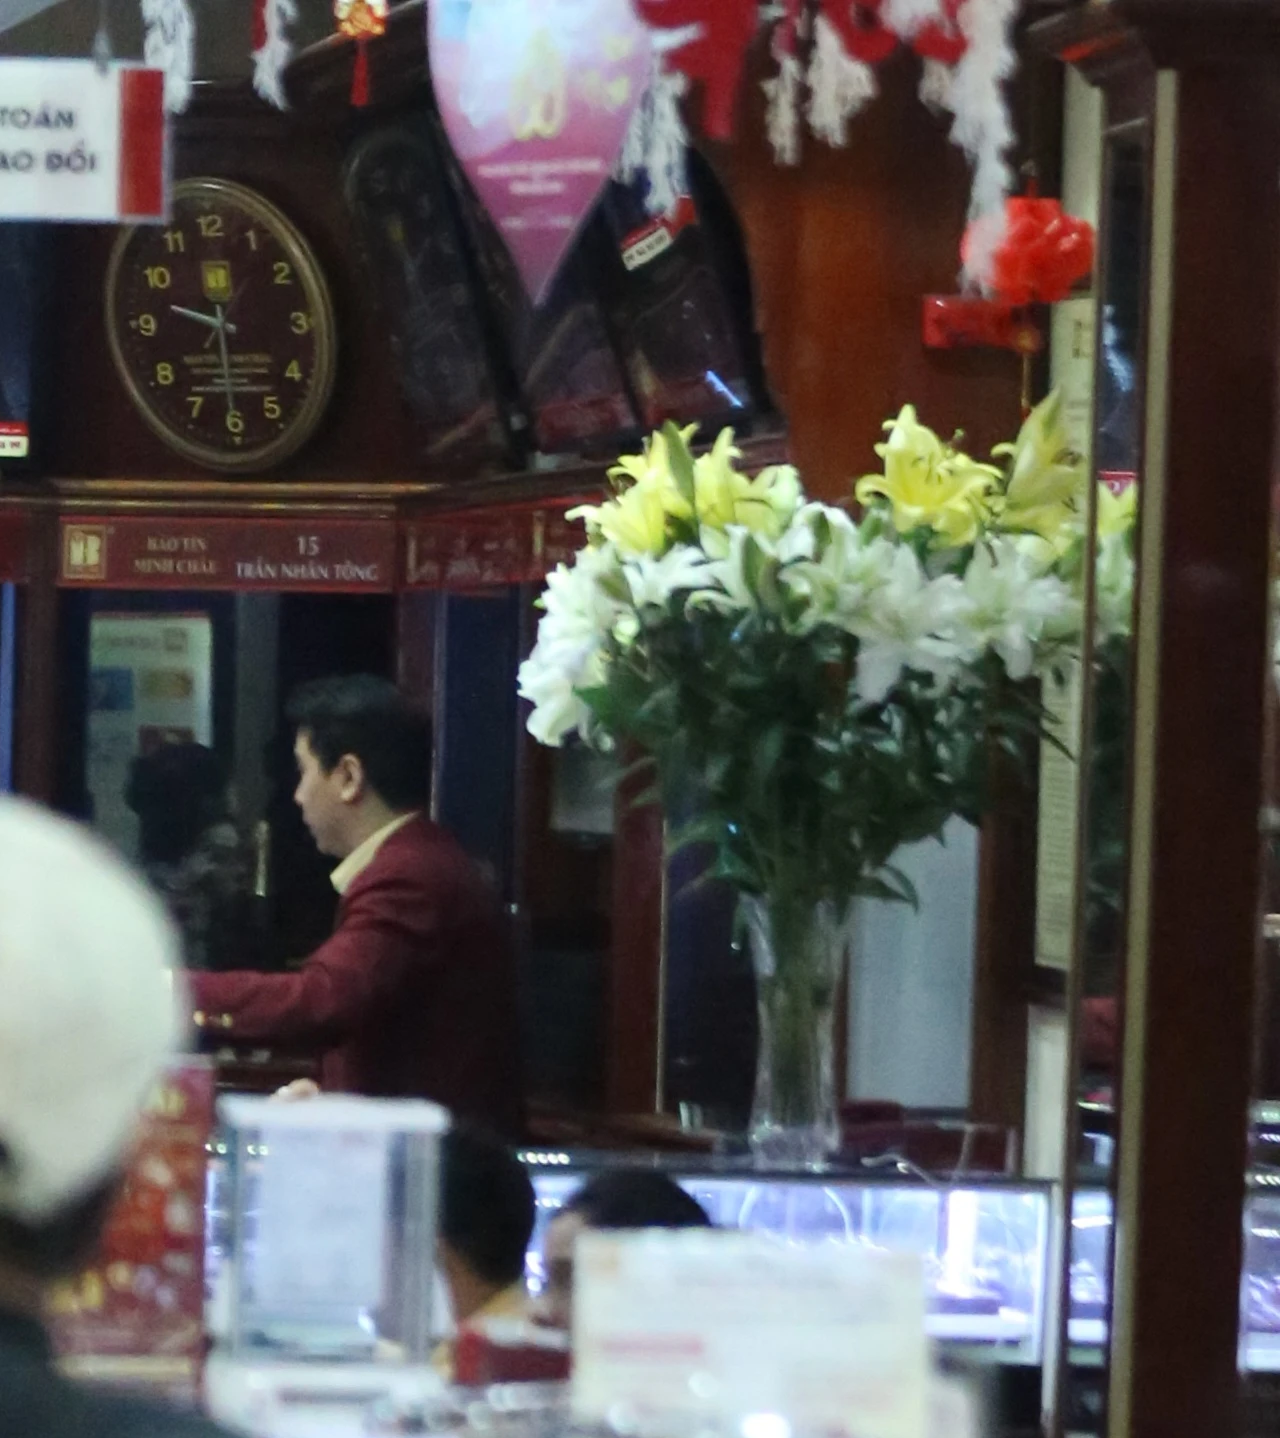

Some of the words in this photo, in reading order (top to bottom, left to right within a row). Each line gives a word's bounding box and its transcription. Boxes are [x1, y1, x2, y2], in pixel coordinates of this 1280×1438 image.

[197, 214, 224, 237] 12
[164, 231, 185, 252] 11
[246, 230, 257, 250] 1
[144, 266, 170, 289] 10
[273, 262, 291, 285] 2
[139, 314, 157, 336] 9
[290, 312, 308, 334] 3
[156, 362, 175, 385] 8
[285, 360, 302, 381] 4
[187, 396, 204, 418] 7
[263, 396, 281, 419] 5
[226, 410, 244, 432] 6
[297, 535, 320, 556] 15
